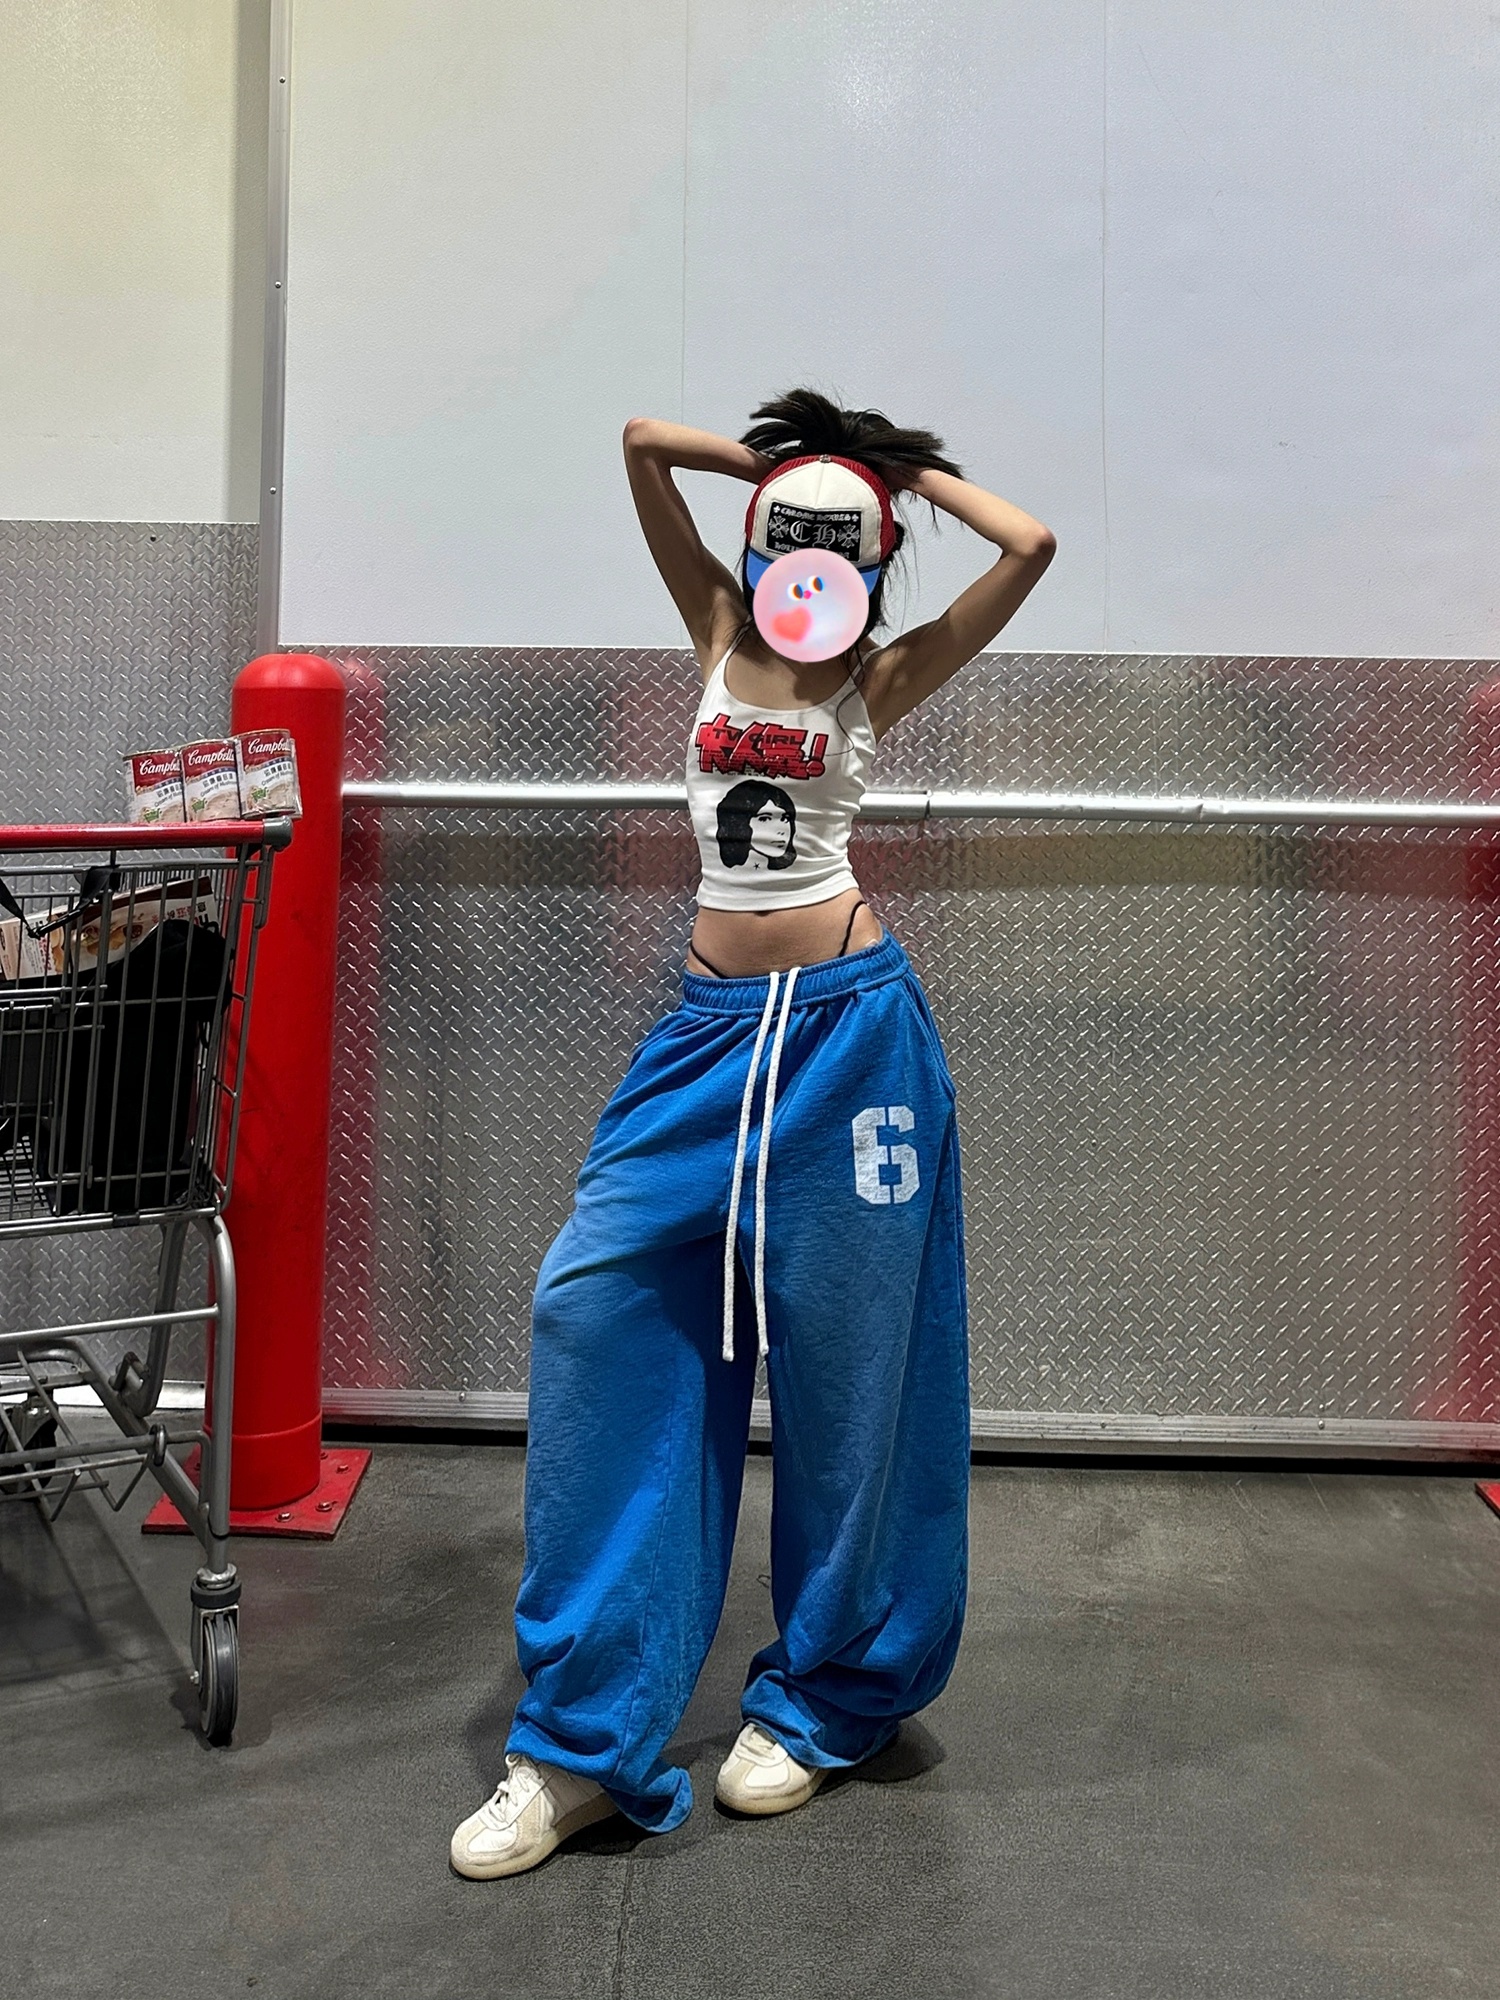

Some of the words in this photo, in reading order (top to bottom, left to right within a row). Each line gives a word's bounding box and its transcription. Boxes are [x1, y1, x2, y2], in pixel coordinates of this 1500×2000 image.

[790, 520, 836, 549] CH
[748, 733, 802, 745] GIRL
[851, 1104, 921, 1205] 6
